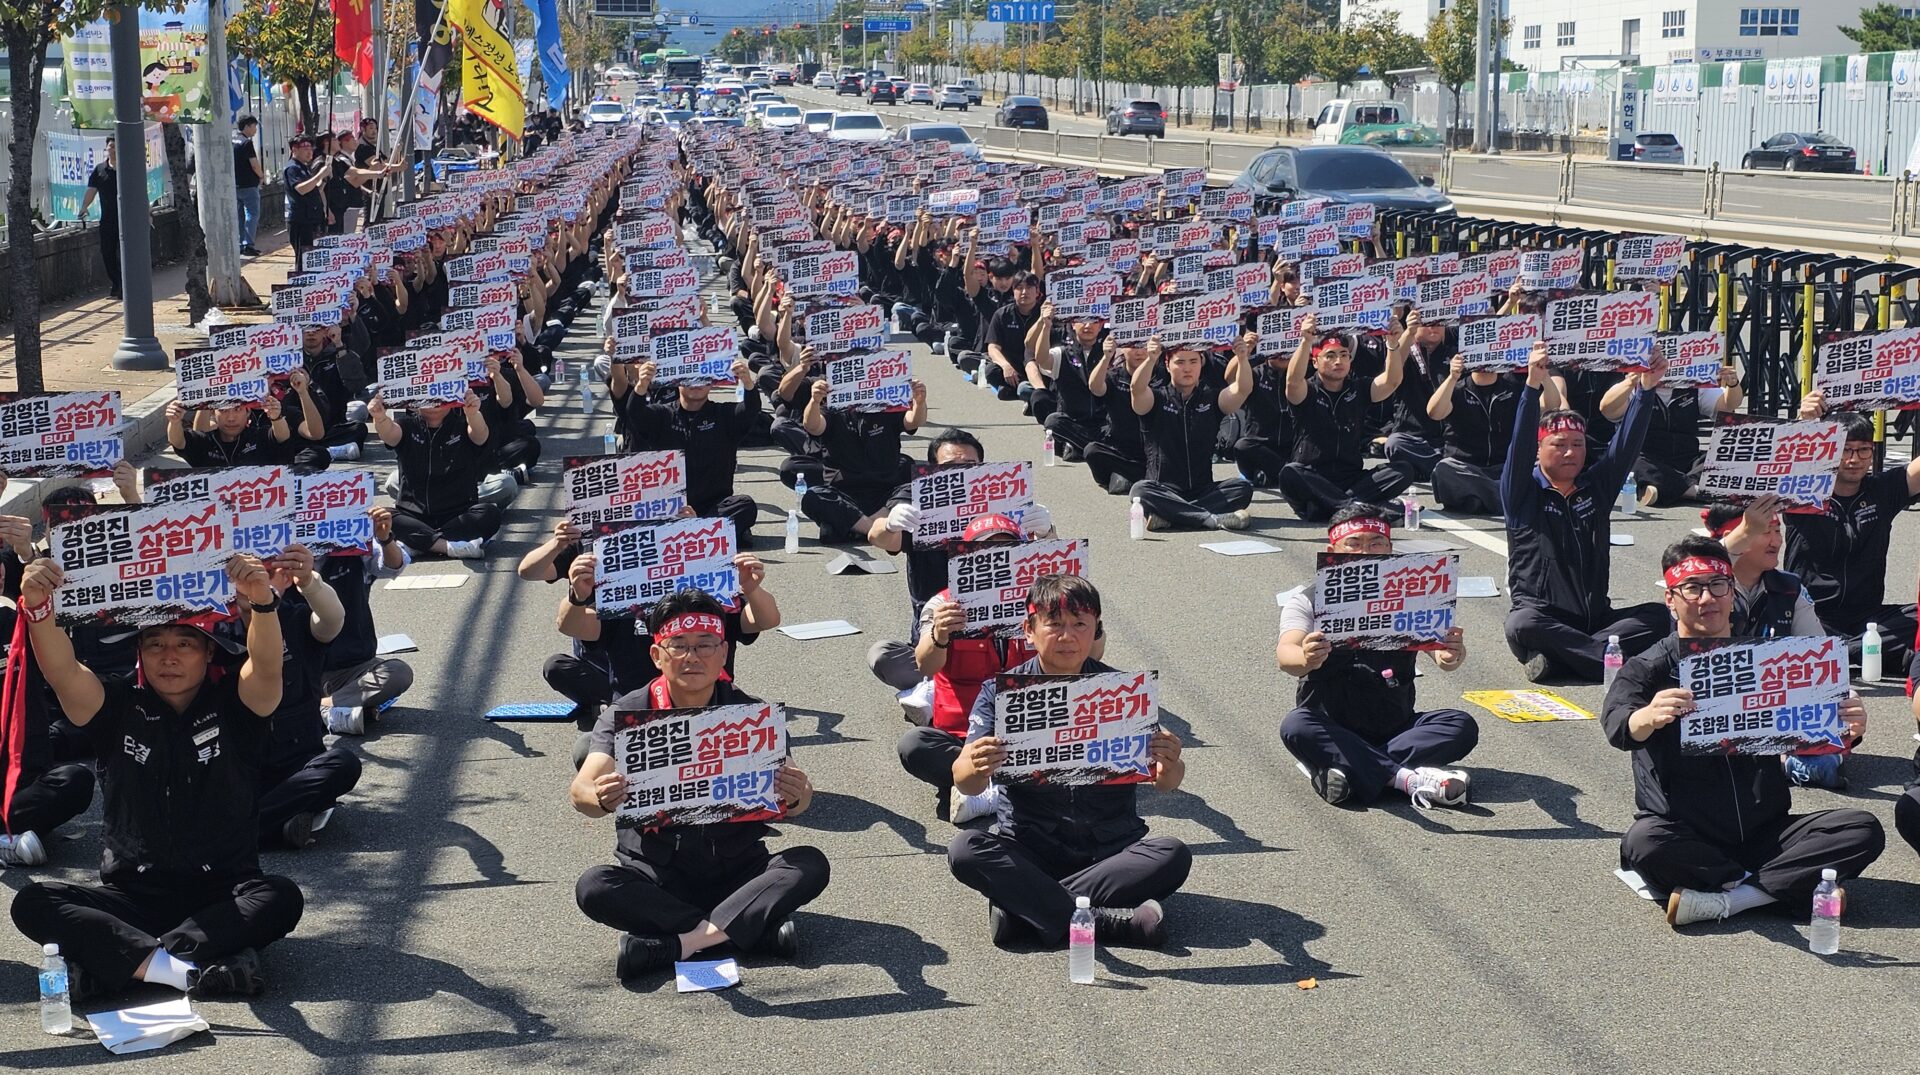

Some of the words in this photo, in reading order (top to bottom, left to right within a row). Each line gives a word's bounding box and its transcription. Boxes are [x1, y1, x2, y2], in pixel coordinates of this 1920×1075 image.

[1716, 49, 1762, 57] 부광테크원
[61, 152, 82, 180] 건강한
[1622, 249, 1651, 259] 임금은
[1654, 247, 1681, 258] 상한가
[1624, 239, 1652, 251] 경영진
[1618, 267, 1636, 275] 조합원
[1638, 267, 1656, 275] 임금은
[1657, 265, 1677, 278] 하한가
[276, 289, 302, 302] 경영진
[276, 298, 303, 310] 임금은
[305, 293, 337, 307] 상한가
[1318, 282, 1348, 299] 경영진
[1318, 294, 1349, 308] 임금은
[1352, 288, 1389, 305] 상한가
[276, 316, 293, 324] 조합원
[294, 313, 311, 322] 임금은
[312, 310, 340, 322] 하한가
[1316, 316, 1336, 326] 조합원
[1338, 313, 1357, 324] 임금은
[1358, 309, 1391, 324] 하한가
[1554, 298, 1598, 319] 경영진
[1552, 314, 1597, 332] 임금은
[1600, 309, 1654, 330] 상한가
[1589, 329, 1614, 338] BUT
[1547, 342, 1576, 356] 조합원
[1578, 340, 1606, 354] 임금은
[1607, 337, 1654, 356] 하한가
[1828, 339, 1872, 362] 경영진
[180, 354, 214, 372] 경영진
[181, 366, 216, 382] 임금은
[218, 357, 261, 377] 상한가
[383, 353, 416, 371] 경영진
[384, 365, 418, 381] 임금은
[421, 358, 462, 376] 상한가
[832, 358, 864, 375] 경영진
[1826, 354, 1872, 375] 임금은
[832, 370, 865, 385] 임금은
[868, 363, 907, 381] 상한가
[861, 380, 878, 388] BUT
[1864, 368, 1890, 379] BUT
[181, 389, 203, 401] 조합원
[205, 385, 226, 397] 임금은
[228, 379, 266, 396] 하한가
[383, 388, 404, 399] 조합원
[406, 385, 428, 396] 임금은
[429, 380, 466, 396] 하한가
[831, 392, 852, 403] 조합원
[854, 389, 874, 400] 임금은
[875, 384, 910, 400] 하한가
[1822, 384, 1851, 399] 조합원
[1854, 380, 1882, 395] 임금은
[1, 400, 49, 424] 경영진
[2, 417, 51, 438] 임금은
[55, 408, 115, 433] 상한가
[45, 433, 71, 444] BUT
[1720, 427, 1775, 449] 경영진
[1, 449, 32, 464] 조합원
[34, 445, 65, 461] 임금은
[67, 439, 120, 461] 하한가
[1716, 445, 1772, 463] 임금은
[1773, 442, 1836, 464] 상한가
[572, 462, 617, 487] 경영진
[1759, 464, 1789, 473] BUT
[153, 478, 209, 500] 경영진
[572, 478, 619, 501] 임금은
[623, 467, 679, 494] 상한가
[920, 472, 964, 497] 경영진
[920, 489, 966, 511] 임금은
[970, 479, 1026, 505] 상한가
[1707, 477, 1742, 491] 조합원
[1744, 476, 1778, 490] 임금은
[1778, 475, 1832, 495] 하한가
[307, 488, 367, 512] 상한가
[613, 492, 638, 504] BUT
[296, 511, 323, 522] BUT
[572, 510, 601, 526] 조합원
[603, 505, 632, 521] 임금은
[634, 496, 684, 519] 하한가
[960, 504, 985, 515] BUT
[62, 516, 130, 551] 경영진
[231, 523, 292, 549] 하한가
[318, 518, 370, 538] 하한가
[918, 521, 947, 536] 조합원
[1364, 518, 1386, 534] 투쟁
[63, 540, 133, 571] 임금은
[138, 525, 224, 562] 상한가
[602, 530, 656, 558] 경영진
[603, 548, 658, 574] 임금은
[663, 536, 728, 566] 상한가
[124, 561, 162, 577] BUT
[651, 565, 681, 578] BUT
[958, 550, 1010, 578] 경영진
[1672, 560, 1695, 578] 단결
[1708, 559, 1728, 575] 투쟁
[62, 585, 106, 607] 조합원
[110, 578, 153, 601] 임금은
[156, 568, 231, 600] 하한가
[958, 569, 1012, 594] 임금은
[1325, 563, 1379, 590] 경영진
[602, 584, 637, 603] 조합원
[640, 579, 674, 597] 임금은
[1324, 582, 1380, 605] 임금은
[1383, 574, 1450, 601] 상한가
[966, 606, 989, 624] 합원
[992, 601, 1025, 619] 임금은
[1370, 600, 1400, 612] BUT
[660, 618, 681, 637] 단결
[698, 616, 722, 634] 투쟁
[1320, 617, 1354, 634] 조합원
[1358, 614, 1392, 630] 임금은
[1394, 609, 1452, 631] 하한가
[1691, 649, 1753, 682] 경영진
[1691, 672, 1756, 701] 임금은
[1761, 660, 1840, 694] 상한가
[1006, 685, 1067, 717] 경영진
[1747, 693, 1782, 708] BUT
[1006, 707, 1069, 735] 임금은
[1073, 695, 1150, 728] 상한가
[1689, 715, 1729, 736] 조합원
[1733, 710, 1773, 731] 임금은
[1776, 702, 1843, 731] 하한가
[626, 720, 690, 755] 경영진
[1059, 726, 1094, 741] BUT
[124, 735, 152, 765] 단결
[626, 743, 692, 774] 임금은
[698, 727, 777, 764] 상한가
[1002, 748, 1041, 768] 조합원
[1045, 742, 1084, 763] 임금은
[1087, 734, 1152, 762] 하한가
[683, 762, 719, 779] BUT
[624, 787, 665, 810] 조합원
[669, 780, 709, 802] 임금은
